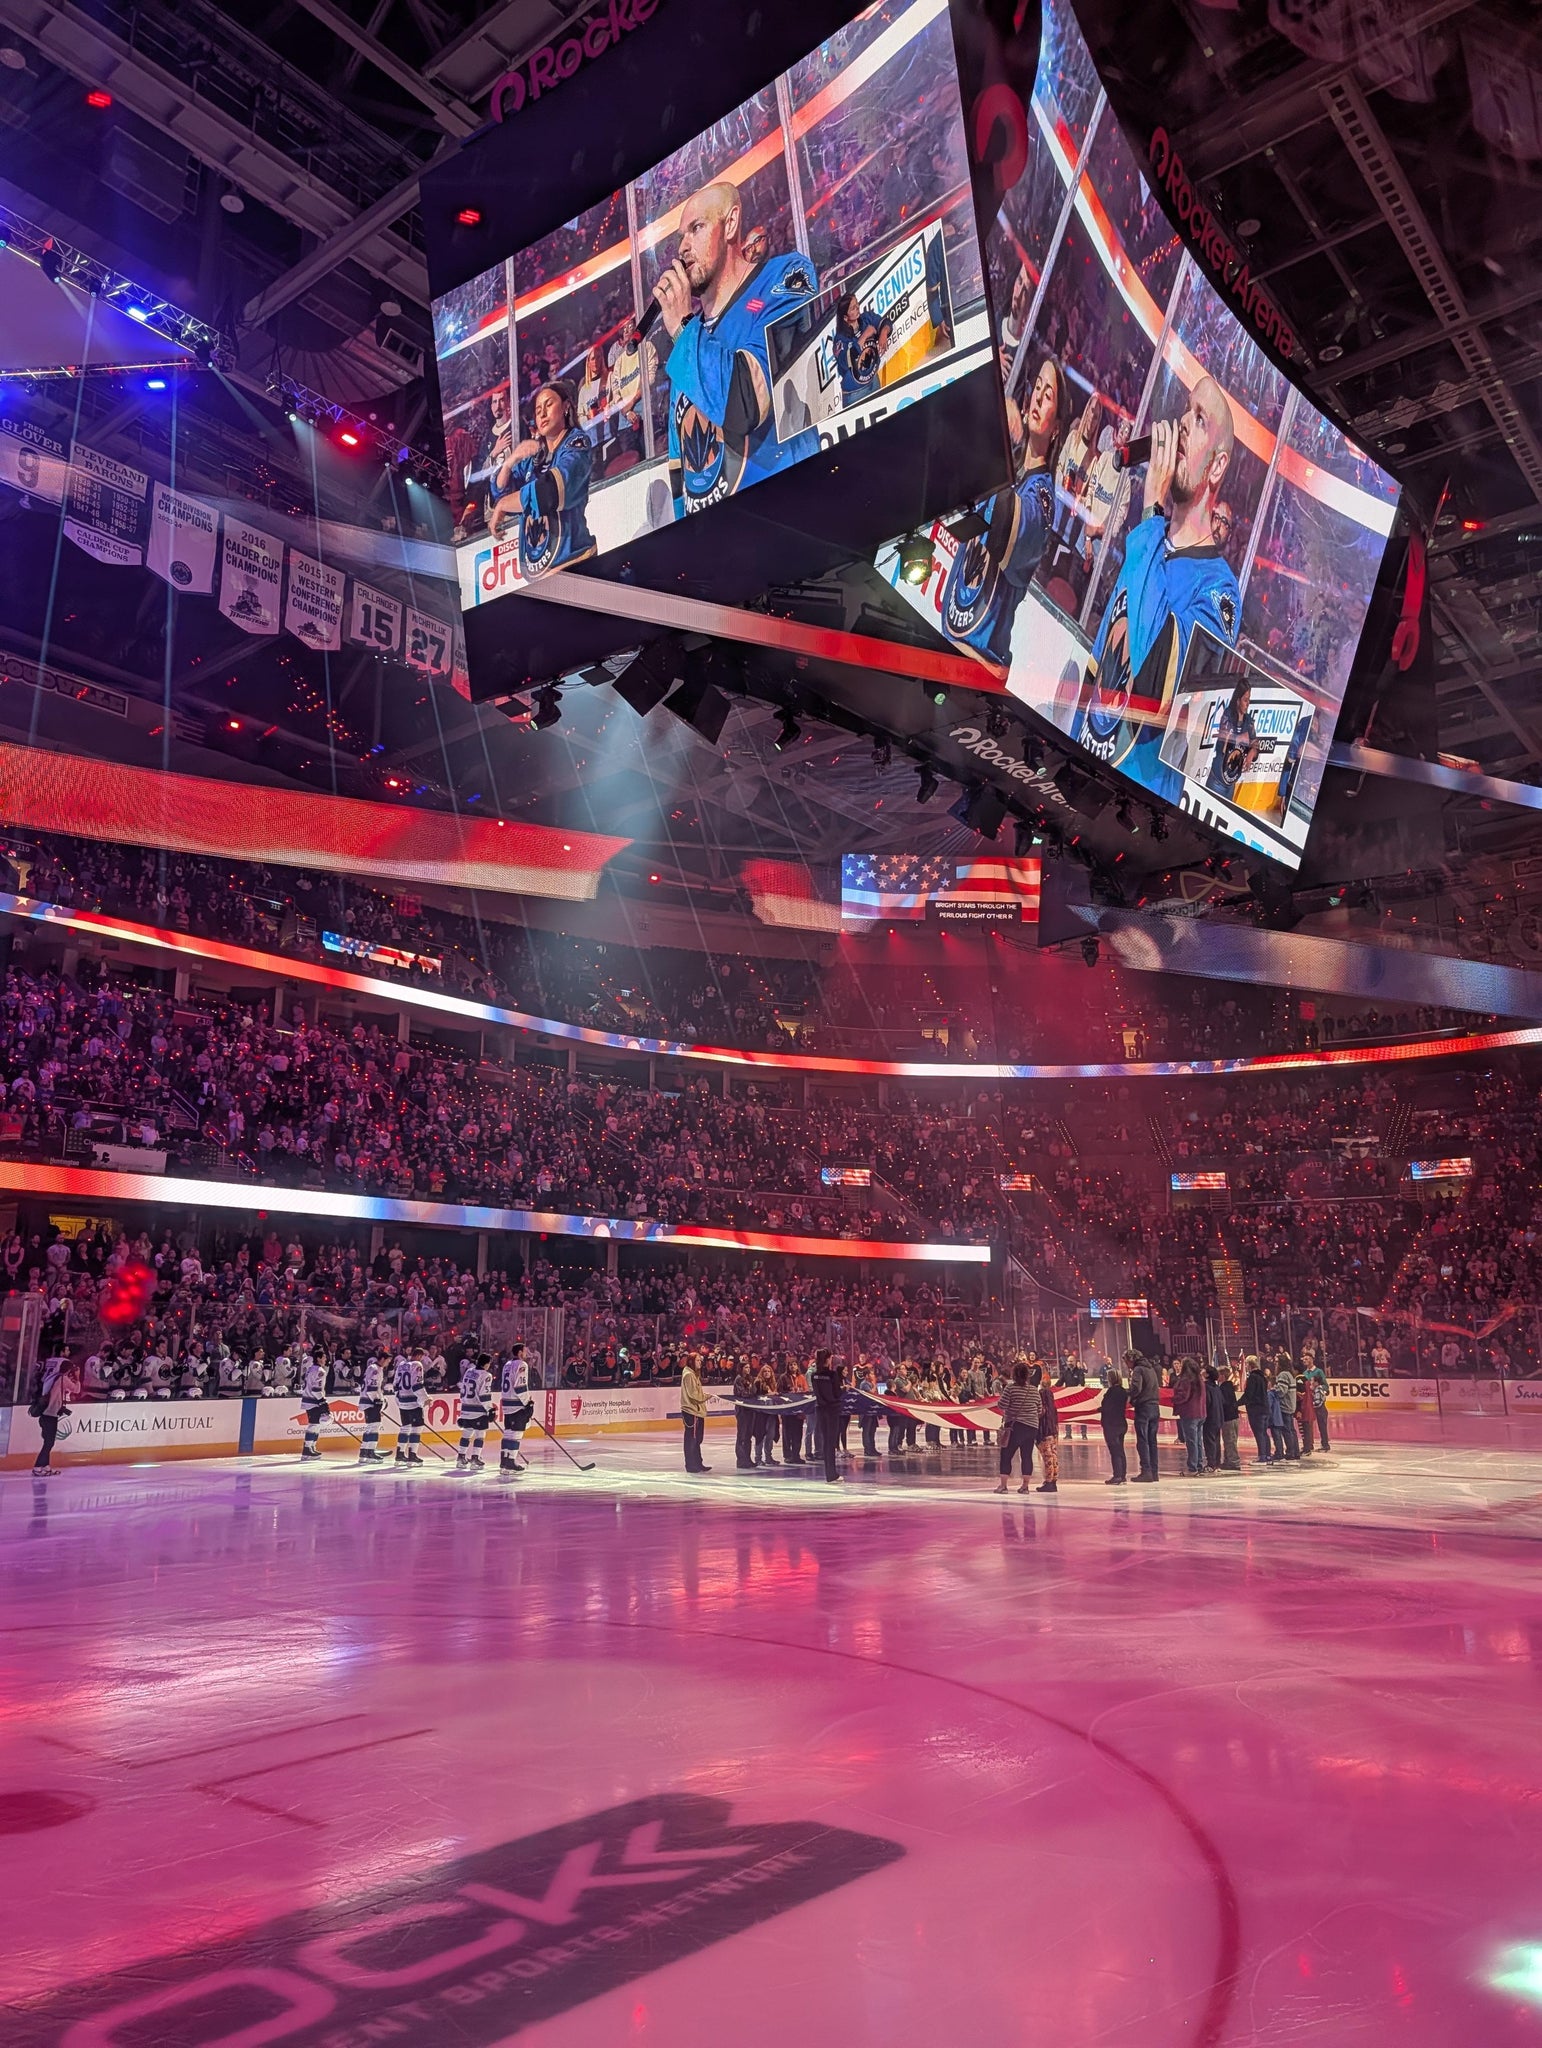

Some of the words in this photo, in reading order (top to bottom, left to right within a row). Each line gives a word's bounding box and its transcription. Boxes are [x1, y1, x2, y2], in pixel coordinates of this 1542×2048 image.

[1165, 151, 1235, 285] Rocket
[1232, 264, 1293, 360] Arena
[887, 301, 928, 348] PERIENCE
[2, 418, 63, 454] GLOVER
[23, 421, 45, 435] FRED
[18, 447, 39, 488] 9
[73, 445, 145, 484] CLEVELAND
[85, 460, 134, 488] BARONS
[158, 499, 213, 533] CHAMPIONS
[161, 491, 183, 508] NORTH
[183, 504, 212, 521] DIVISION
[76, 528, 111, 549] CALDER
[113, 543, 130, 556] CUP
[76, 536, 129, 562] CHAMPIONS
[225, 538, 259, 564] CALDER
[261, 555, 280, 571] CUP
[241, 530, 266, 550] 2016
[225, 553, 278, 585] CHAMPIONS
[297, 560, 337, 586] 2015-16
[291, 584, 340, 615] CONFERENCE
[297, 575, 336, 600] WESTERN
[357, 586, 399, 614] CALLANDER
[292, 597, 337, 626] CHAMPIONS
[360, 603, 393, 647] 15
[410, 627, 446, 671] 27
[1250, 762, 1284, 774] PERIENCE
[1326, 1383, 1390, 1397] TEDSEC
[582, 1401, 608, 1409] University
[76, 1418, 148, 1433] MEDICAL
[151, 1416, 213, 1431] MUTUAL
